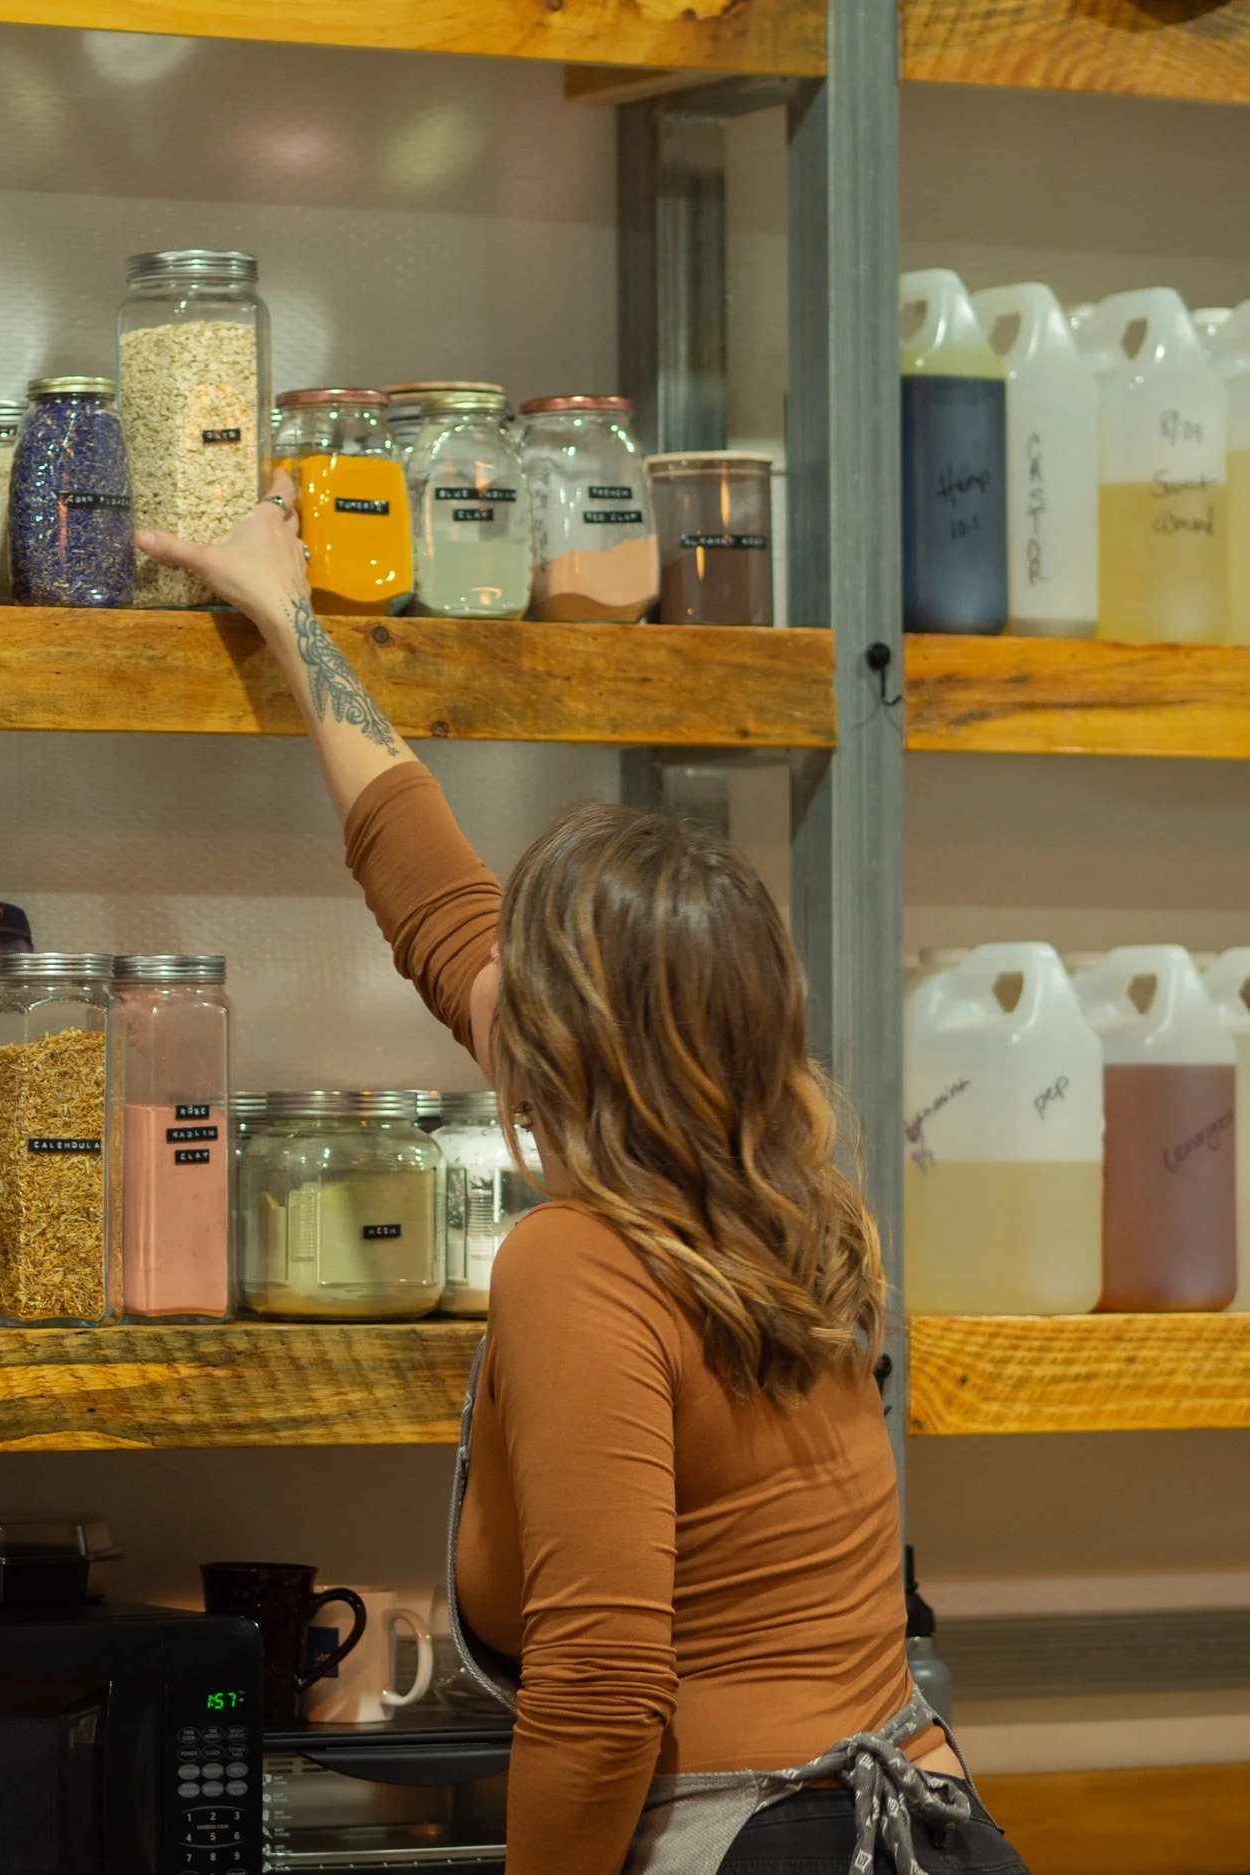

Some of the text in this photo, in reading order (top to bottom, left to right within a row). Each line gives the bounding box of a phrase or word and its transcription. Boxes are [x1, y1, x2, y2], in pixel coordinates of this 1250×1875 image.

[180, 1106, 206, 1116] ROSE
[172, 1129, 215, 1138] KAOLIN
[33, 1141, 100, 1149] CALENDULA
[180, 1151, 208, 1161] CLAY
[206, 1692, 238, 1710] 1:57
